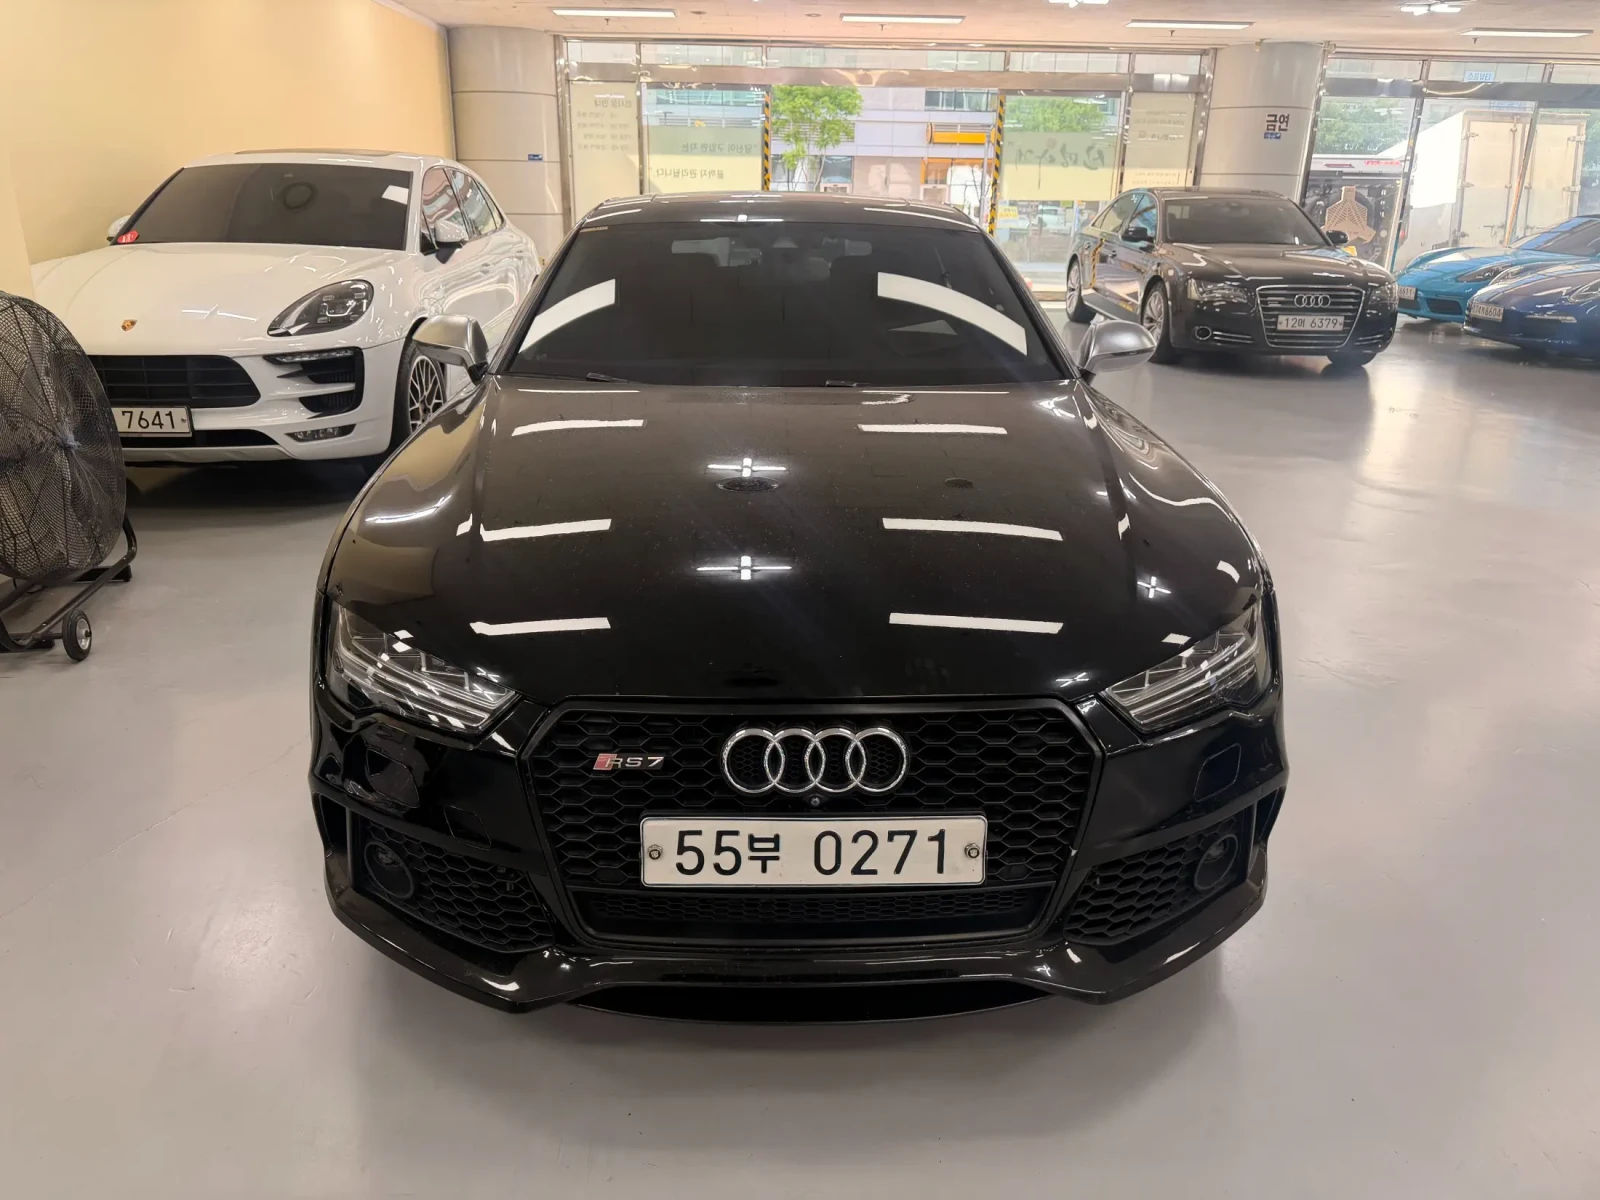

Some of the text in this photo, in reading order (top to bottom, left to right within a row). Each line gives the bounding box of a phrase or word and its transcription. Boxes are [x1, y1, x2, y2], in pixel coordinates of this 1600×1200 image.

[1265, 113, 1290, 132] 금연
[1309, 317, 1338, 329] 6379
[121, 410, 177, 430] 7641
[675, 829, 947, 876] 55부 0271
